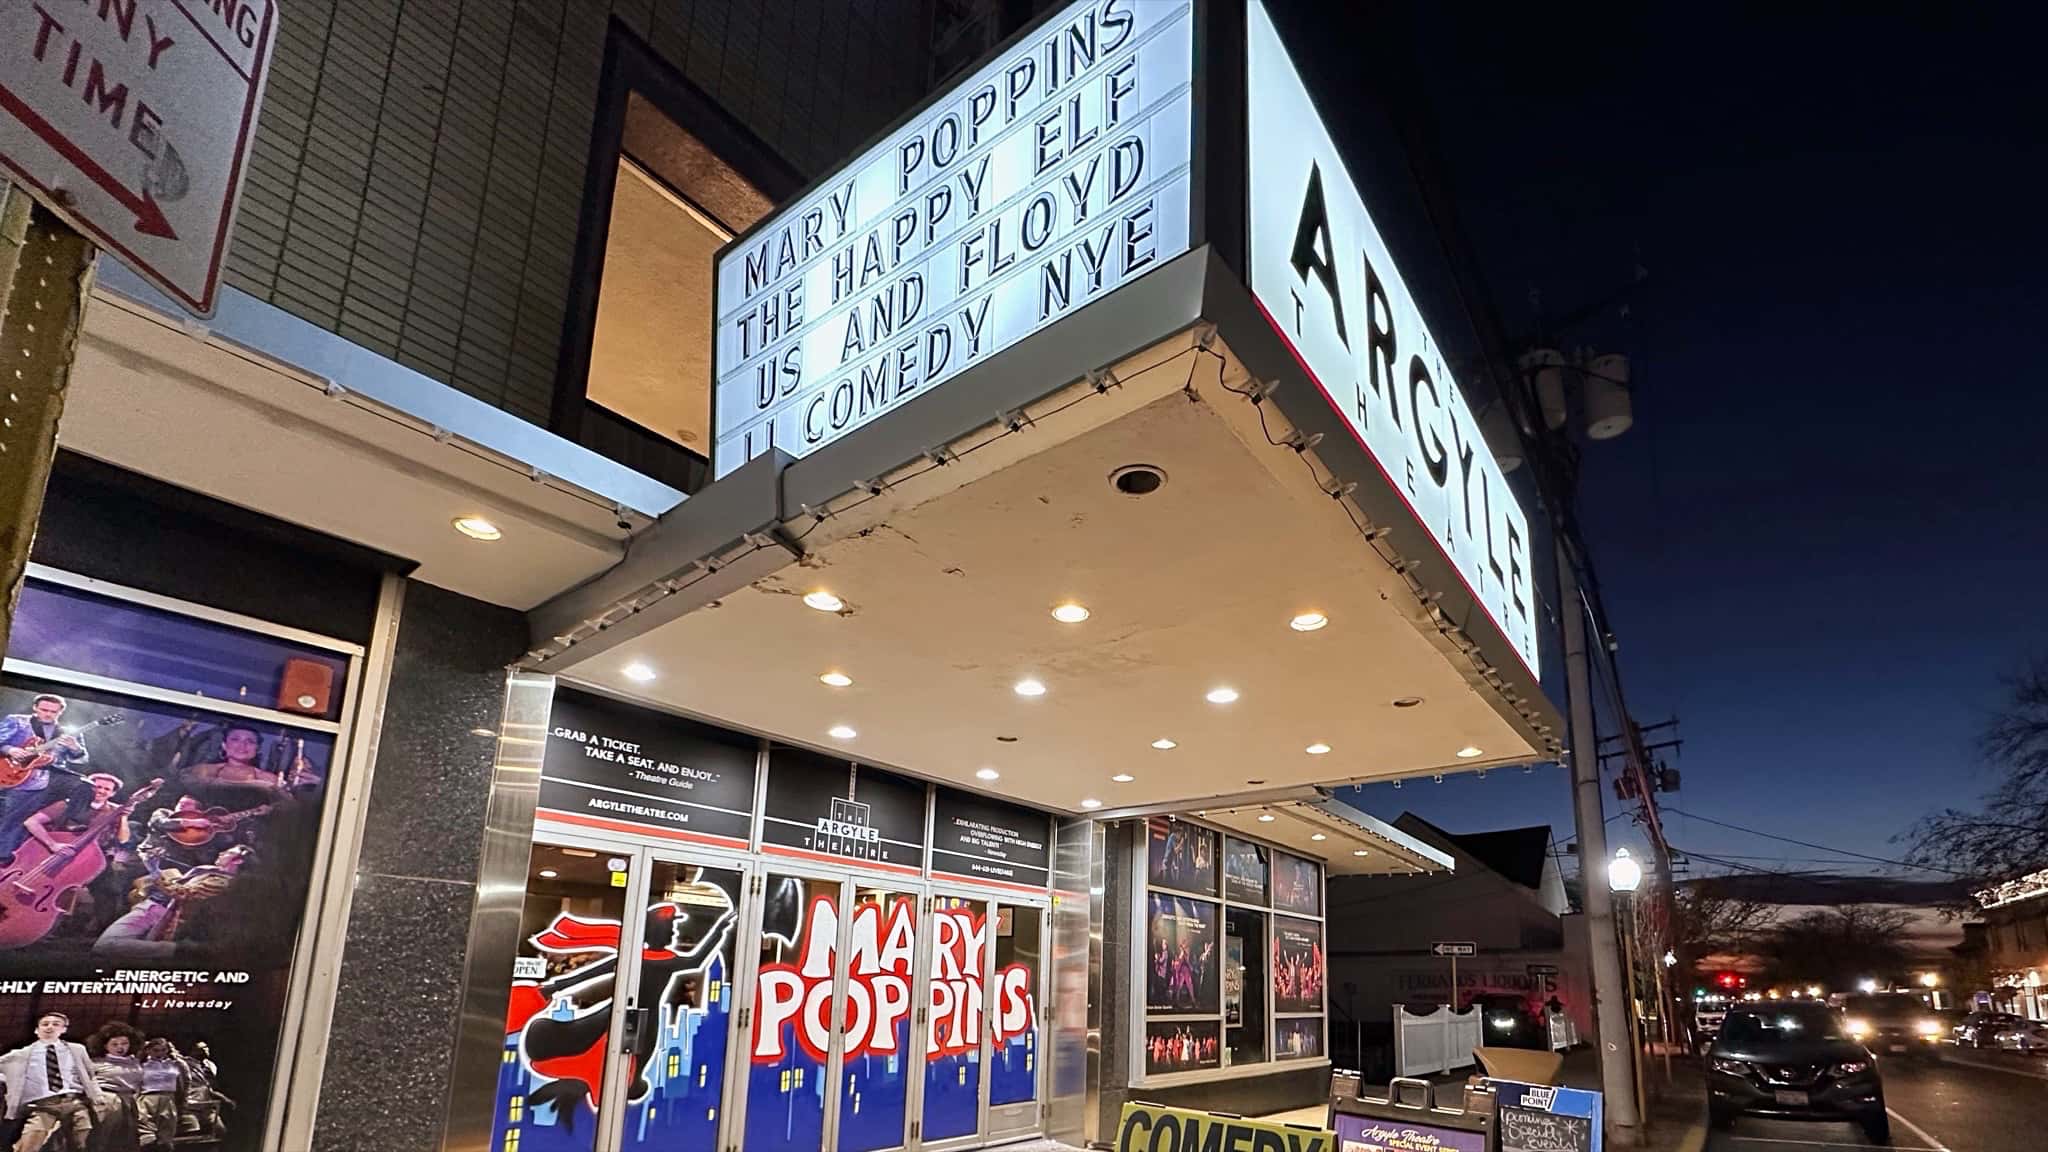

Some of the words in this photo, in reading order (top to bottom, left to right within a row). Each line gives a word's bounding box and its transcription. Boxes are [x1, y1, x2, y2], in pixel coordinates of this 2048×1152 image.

[82, 0, 175, 70] NY
[33, 2, 163, 160] TIME
[744, 178, 857, 298] MARY
[899, 0, 1134, 196] POPPINS
[736, 280, 803, 361] THE
[831, 152, 993, 305] HAPPY
[1033, 54, 1136, 178] ELF
[755, 346, 801, 410] US
[840, 271, 924, 364] AND
[958, 134, 1145, 297] FLOYD
[803, 293, 993, 444] COMEDY
[1038, 199, 1156, 322] NYE
[1290, 157, 1528, 625] ARGYLE
[1290, 286, 1531, 662] THEATRE
[589, 735, 599, 746] A
[601, 736, 641, 754] TICKET.
[584, 746, 615, 761] TAKE
[615, 754, 625, 764] A
[627, 755, 655, 770] SEAT.
[657, 762, 679, 774] AND
[635, 770, 668, 785] Theatre
[668, 776, 694, 790] Guide
[588, 798, 689, 823] ARGYLETHEATRE.COM
[837, 812, 863, 824] THE
[820, 821, 878, 841] ARGYLE
[804, 837, 888, 860] THEATRE
[801, 898, 988, 980] MARY
[0, 981, 37, 994] HLY
[214, 971, 249, 983] AND
[164, 1000, 232, 1010] Newsday
[754, 967, 1028, 1057] POPPINS
[1522, 1097, 1548, 1107] POINT
[1530, 1089, 1551, 1099] BLUE
[1361, 1124, 1400, 1143] Argyle
[1400, 1129, 1440, 1146] Theatre
[1389, 1138, 1415, 1150] SPECIAL
[1415, 1142, 1437, 1152] EVENT
